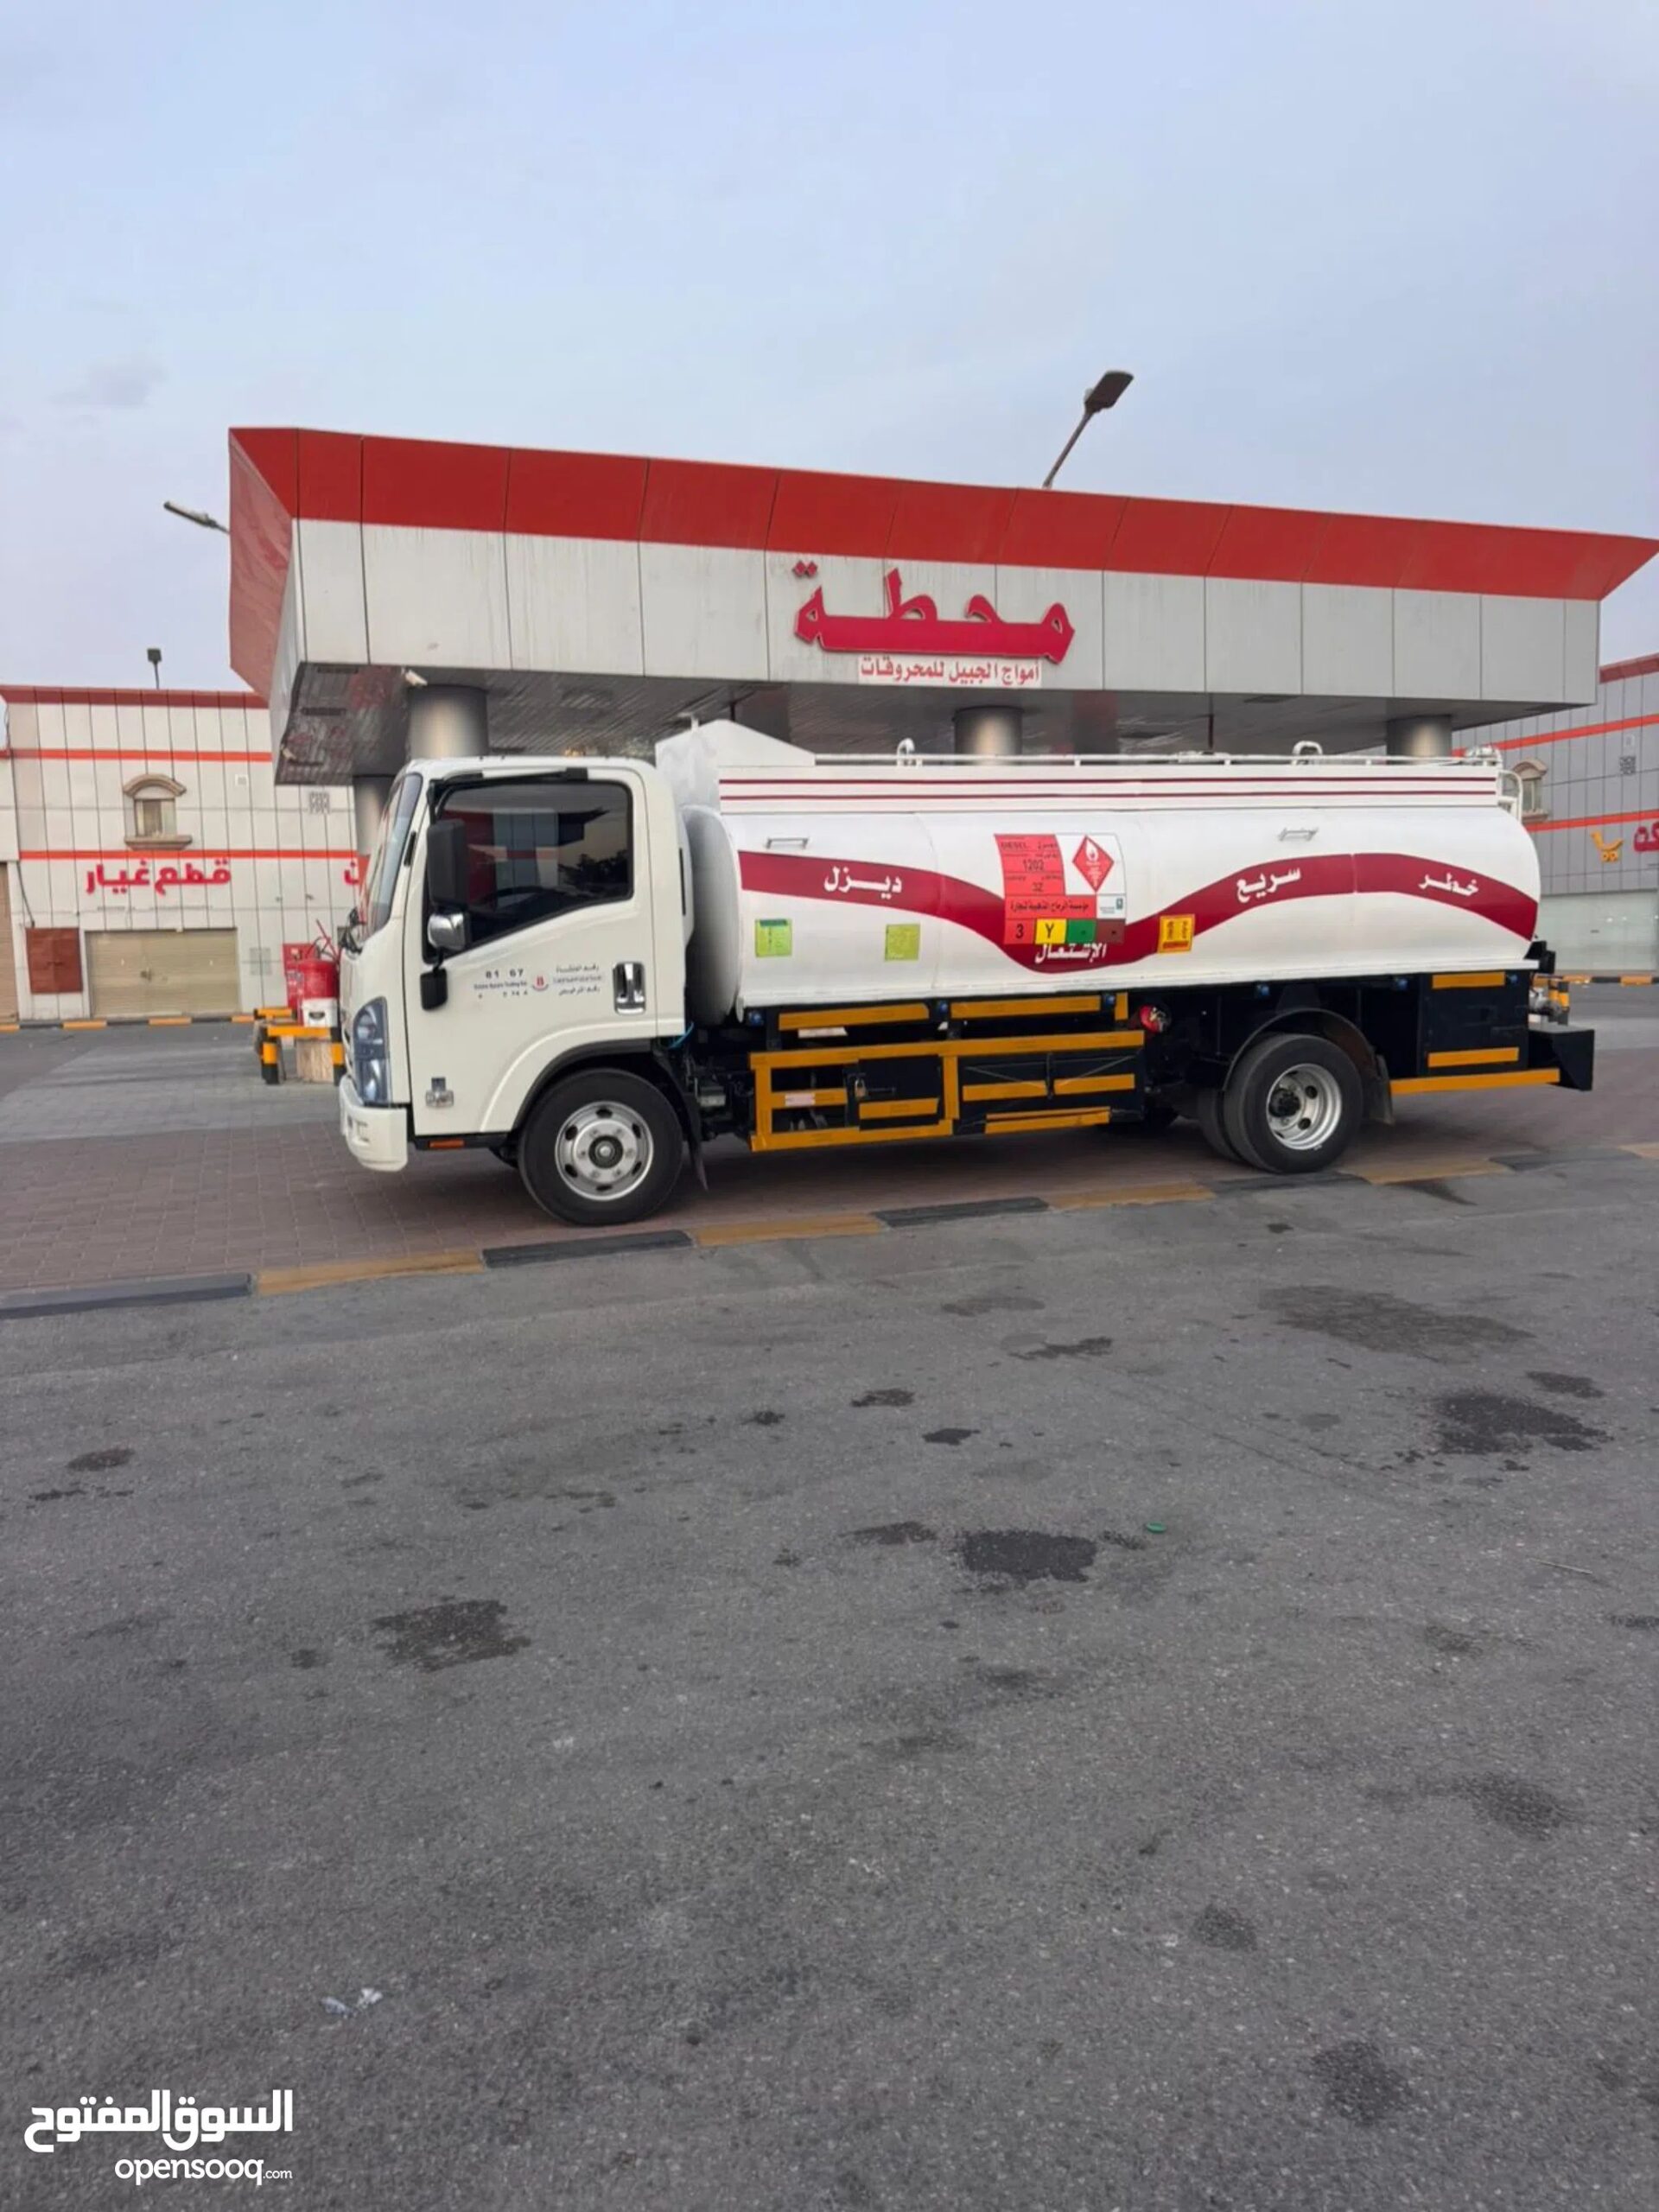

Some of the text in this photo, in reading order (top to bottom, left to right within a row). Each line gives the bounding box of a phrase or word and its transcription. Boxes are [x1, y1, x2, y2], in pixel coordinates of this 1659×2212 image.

[791, 560, 1075, 665] محطة
[859, 657, 945, 682] للمحروقات
[950, 664, 999, 685] الجبيل
[86, 858, 232, 895] قطع غيار
[1022, 859, 1046, 872] 1202
[823, 866, 903, 899] ديزل
[1236, 868, 1301, 902] سريع
[1419, 873, 1479, 896] خطر
[1015, 924, 1055, 939] 3 Y
